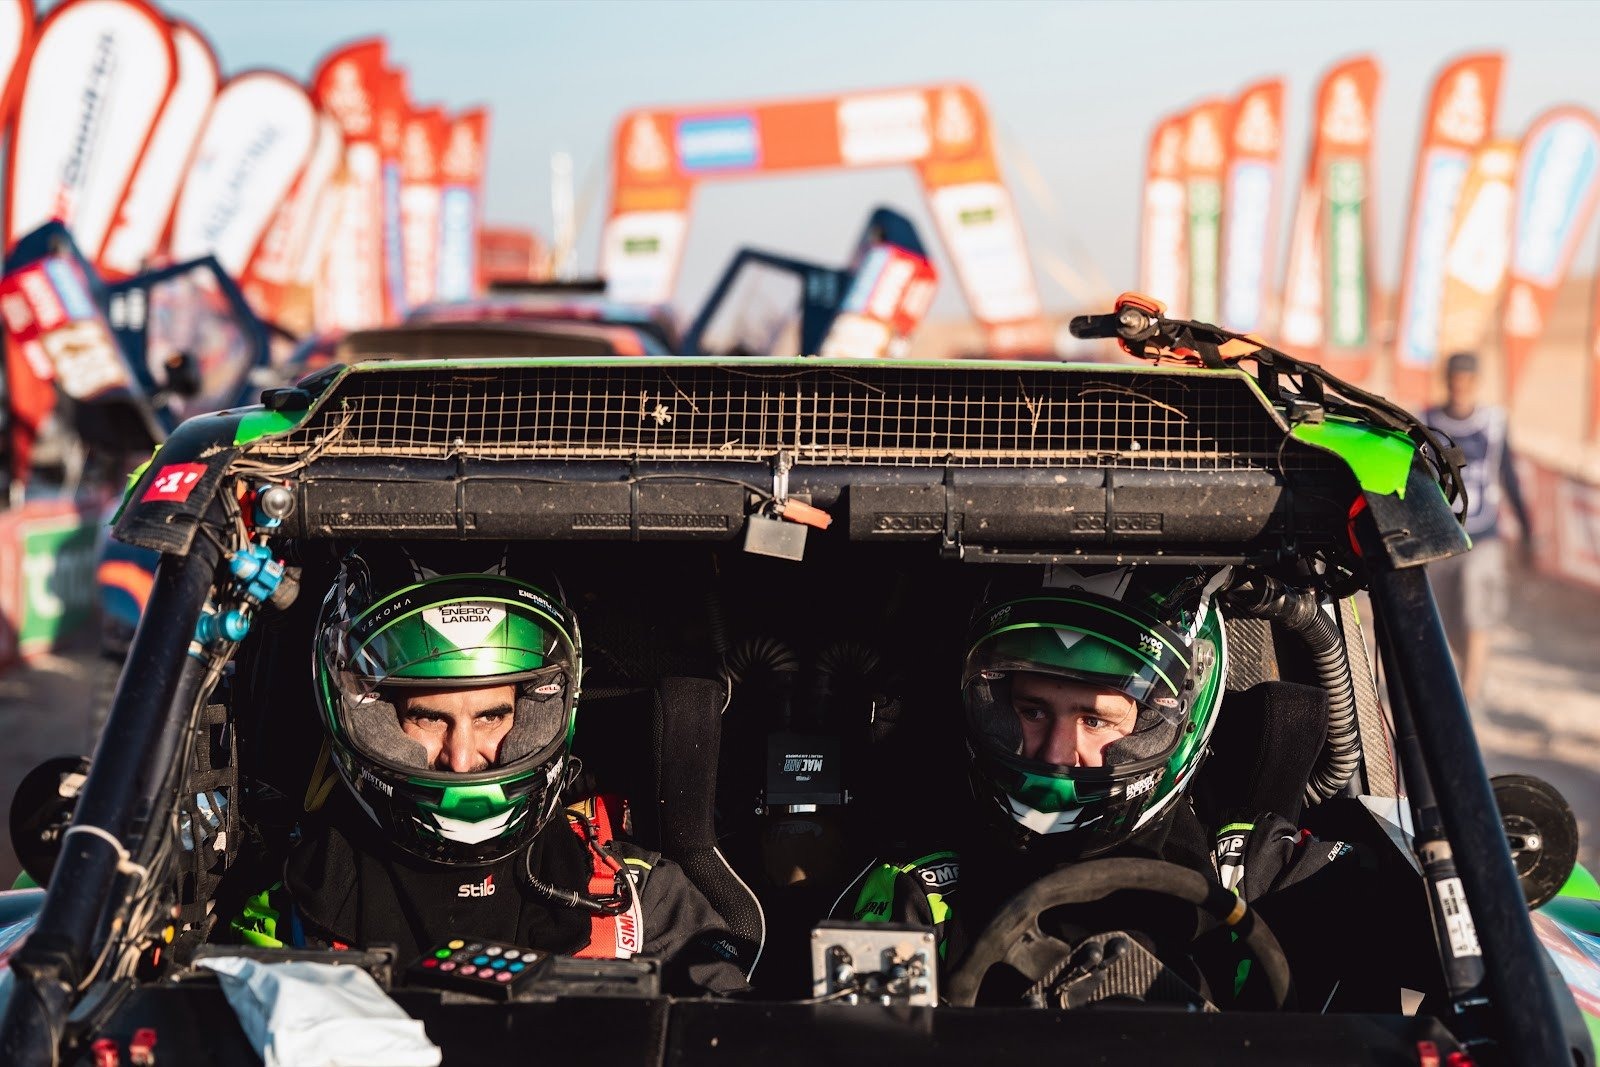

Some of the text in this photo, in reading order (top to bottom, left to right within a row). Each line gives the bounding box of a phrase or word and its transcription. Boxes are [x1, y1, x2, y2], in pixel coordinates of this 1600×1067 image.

[361, 598, 411, 632] VEKOMA
[441, 607, 492, 616] ENERGY
[442, 615, 491, 624] LANDIA
[1137, 641, 1162, 662] 222
[783, 758, 823, 772] AIR MAC
[361, 766, 394, 798] WESTERN
[1126, 774, 1155, 795] ENERGY
[1217, 838, 1244, 857] MP
[1327, 841, 1345, 862] ENER
